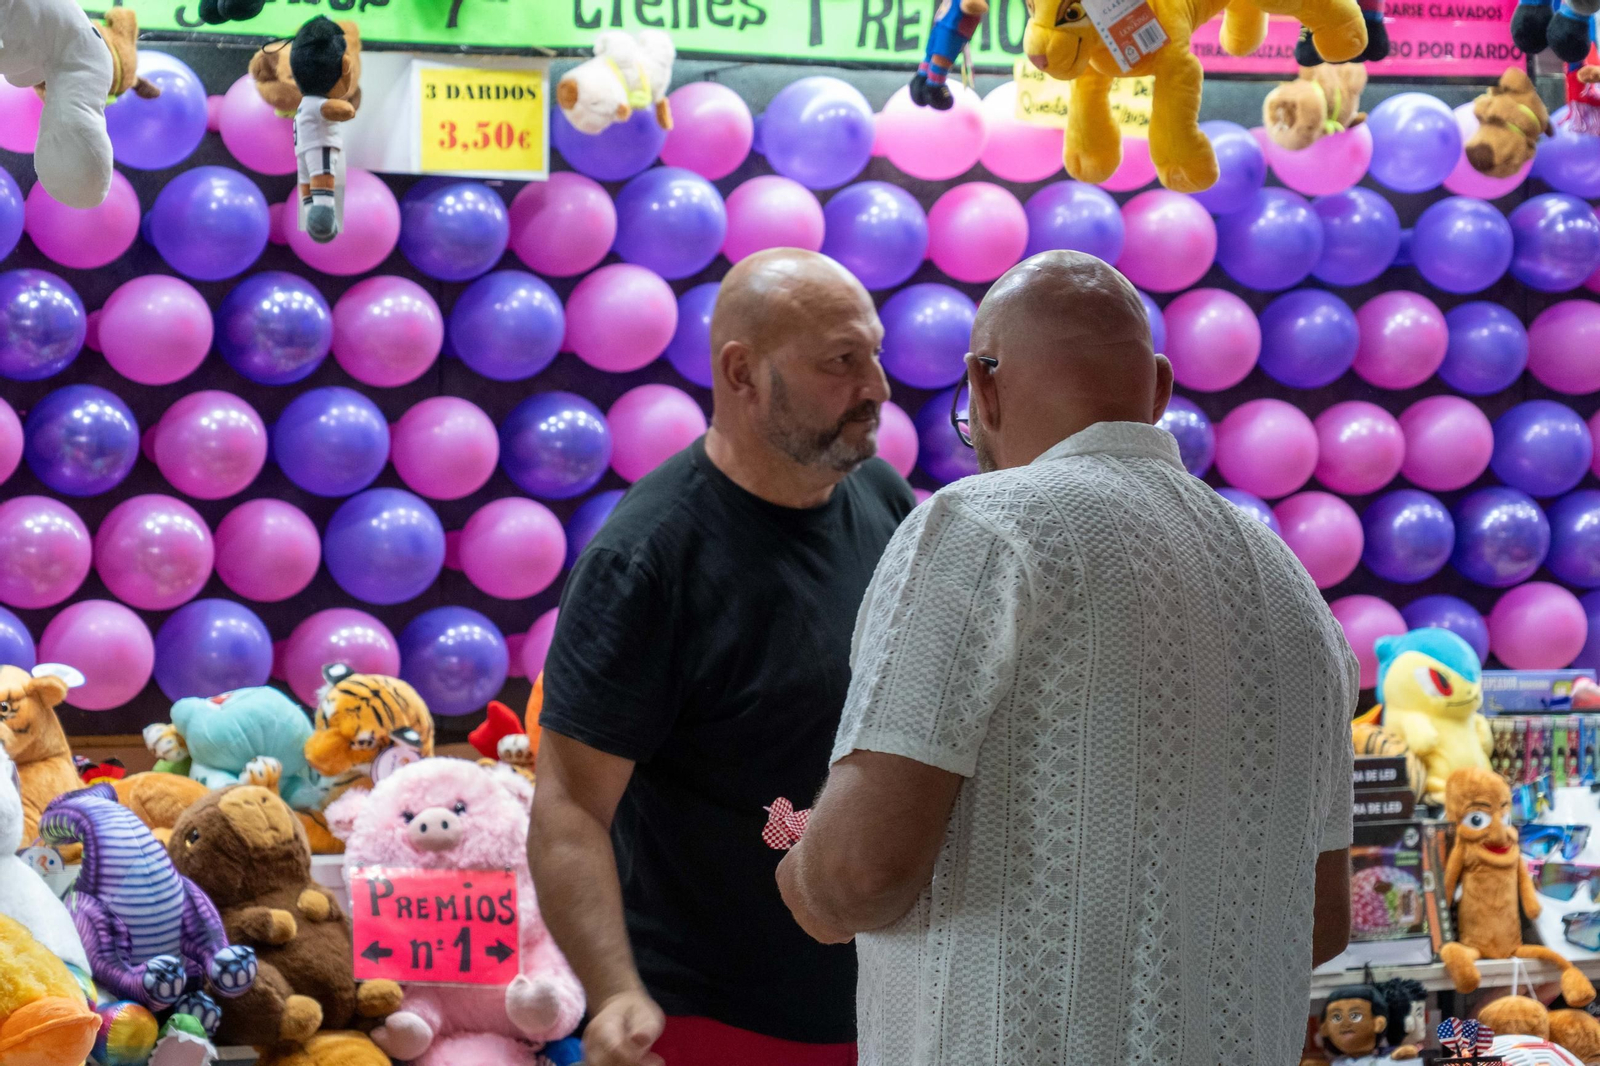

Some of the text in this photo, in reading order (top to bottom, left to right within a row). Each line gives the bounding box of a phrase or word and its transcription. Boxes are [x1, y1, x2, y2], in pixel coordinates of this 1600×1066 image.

[1428, 4, 1503, 20] CLAVADOS
[1418, 42, 1455, 59] POR
[1460, 43, 1523, 60] DARDO
[426, 83, 537, 100] 3 DARDOS
[439, 120, 531, 151] 3,50€
[1365, 769, 1378, 782] DE
[1379, 768, 1397, 781] LED
[1367, 802, 1381, 814] DE
[1382, 801, 1403, 814] LED
[453, 926, 472, 972] 1
